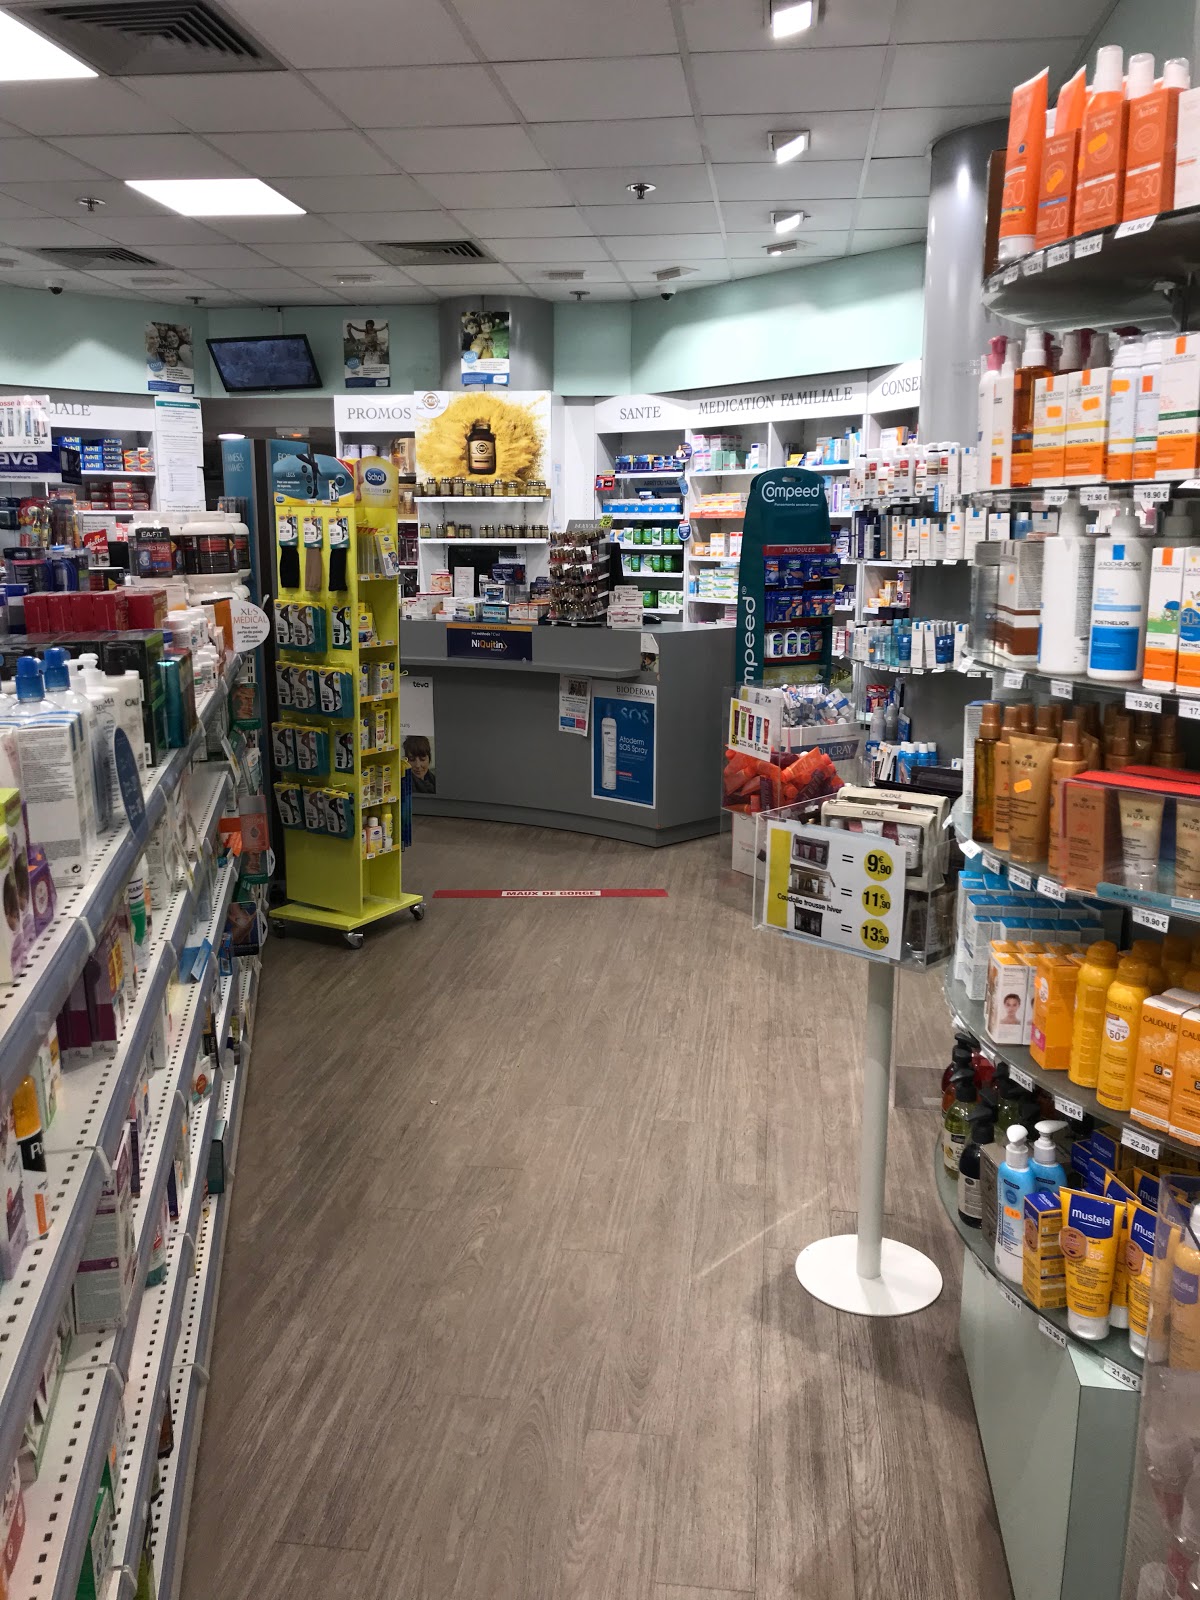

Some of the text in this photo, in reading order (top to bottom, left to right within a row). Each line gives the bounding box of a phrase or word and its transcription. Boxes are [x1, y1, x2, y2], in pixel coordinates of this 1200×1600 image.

[1098, 184, 1116, 209] 20
[1050, 206, 1068, 230] 20
[699, 386, 853, 415] MEDICATION FAMILIALE
[347, 407, 412, 420] PROMOS
[620, 406, 661, 420] SANTE
[367, 474, 387, 483] Scholl
[762, 481, 819, 502] Compeed
[1087, 493, 1102, 501] 21.90
[1143, 490, 1168, 499] 18.90 €
[233, 616, 267, 624] MEDICAL
[472, 639, 504, 649] NiQuitin
[616, 686, 655, 697] BIODERMA
[1134, 699, 1159, 710] 19.90 €
[619, 736, 645, 745] Atoderm
[632, 745, 648, 755] Spray
[1015, 759, 1038, 767] NUXE
[804, 899, 826, 911] trousse
[826, 904, 843, 914] hiver
[1141, 915, 1167, 928] 19.90 €
[1109, 1030, 1126, 1041] 50+
[1151, 1148, 1157, 1156] €
[1071, 1208, 1111, 1226] mustela
[1111, 1367, 1137, 1387] 21.90 €
